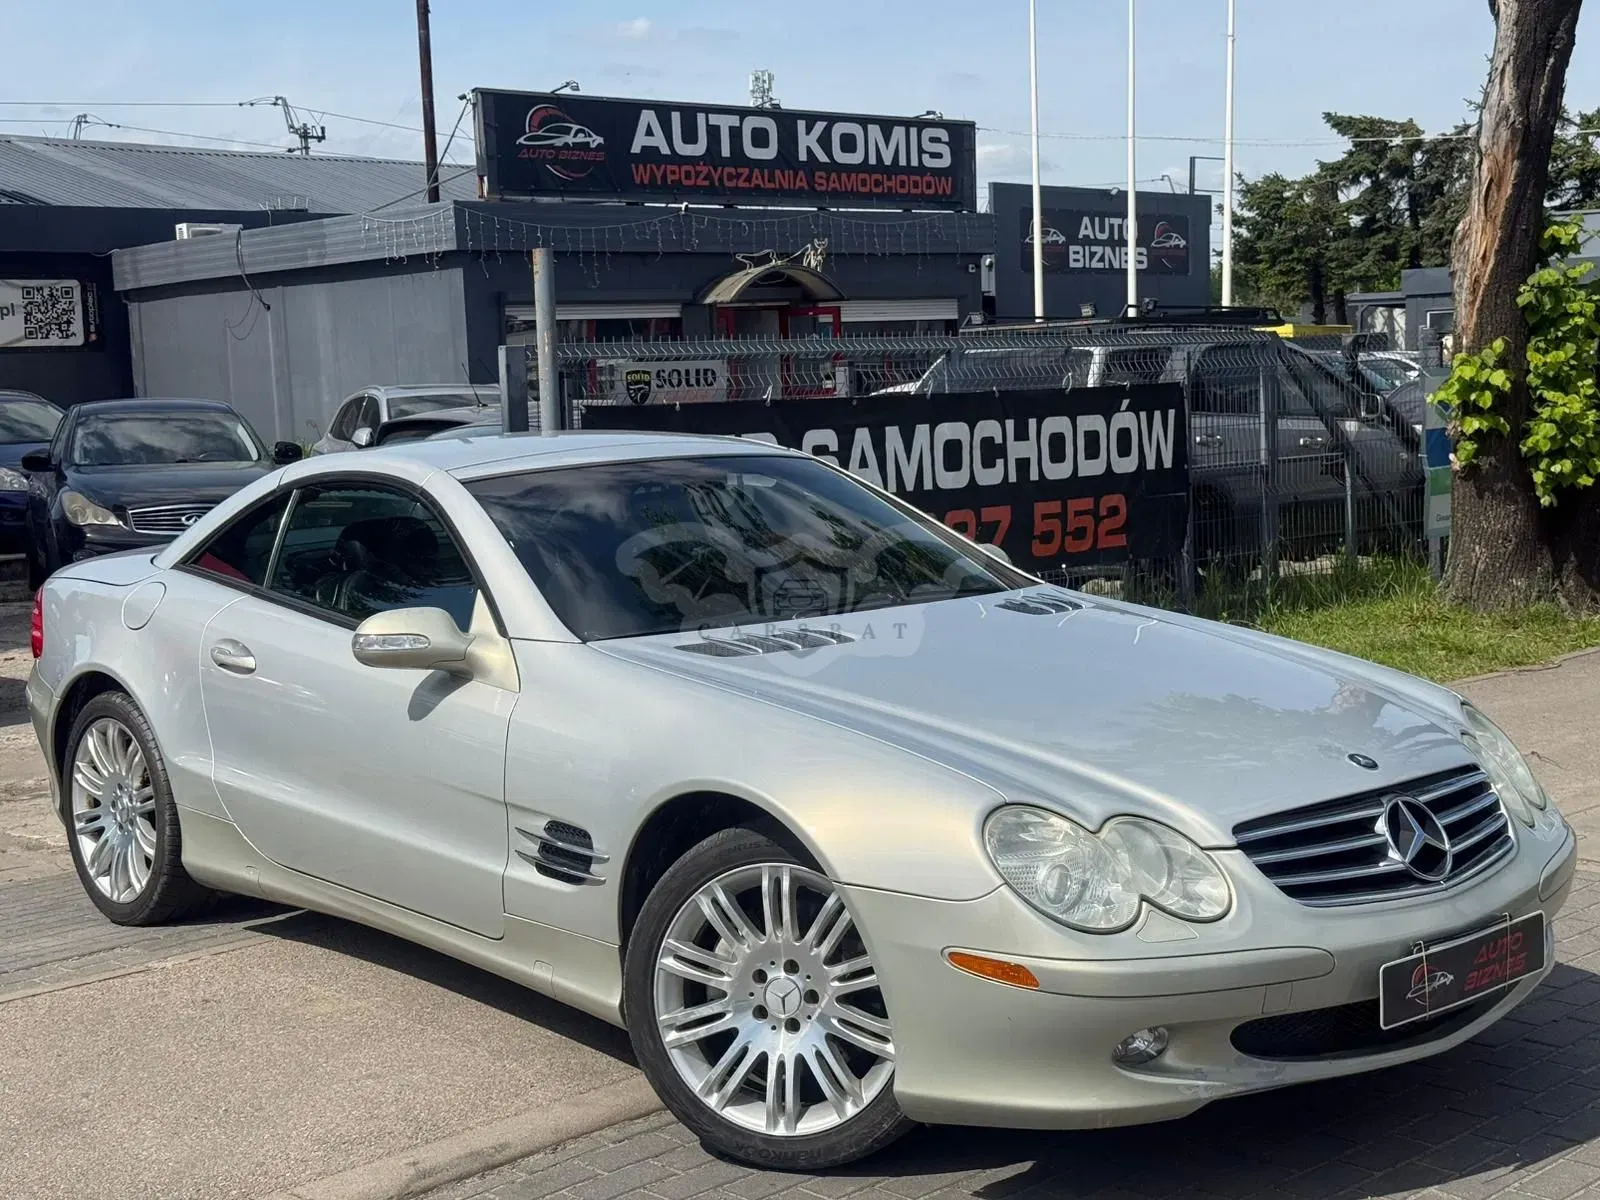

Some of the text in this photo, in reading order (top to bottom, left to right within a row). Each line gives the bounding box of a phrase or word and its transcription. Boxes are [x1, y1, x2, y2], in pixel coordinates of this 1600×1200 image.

[517, 148, 605, 161] AUTO BIZNES
[630, 109, 952, 169] AUTO KOMIS
[631, 161, 952, 196] WYPOŻYCZALNIA SAMOCHODÓW
[626, 373, 651, 383] SOLID
[655, 368, 718, 389] SOLID
[801, 398, 1176, 494] SAMOCHODÓW
[1031, 493, 1128, 558] 552
[1474, 932, 1523, 963] AUTO
[1464, 952, 1528, 991] BIZNES
